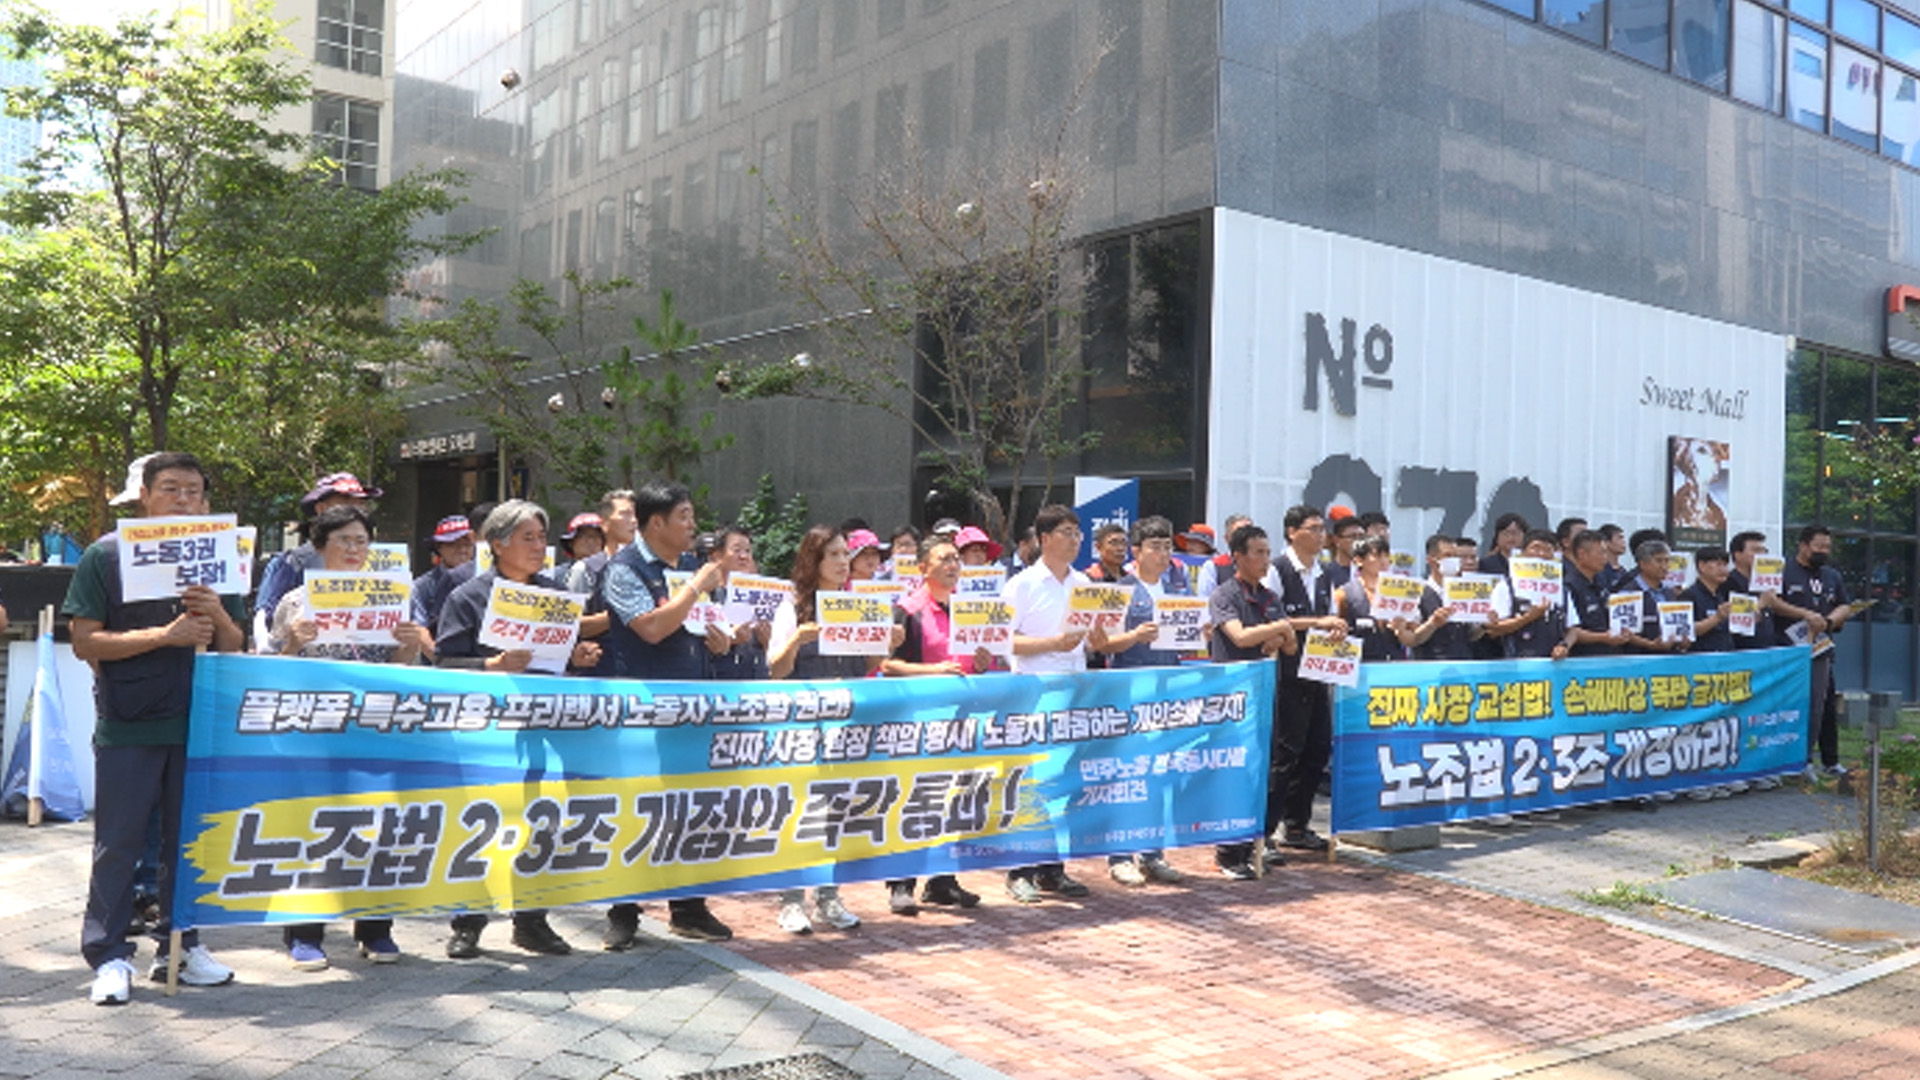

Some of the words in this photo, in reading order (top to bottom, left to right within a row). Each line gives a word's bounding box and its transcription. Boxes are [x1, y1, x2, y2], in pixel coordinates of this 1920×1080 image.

[1640, 376, 1695, 411] Sweet
[1698, 387, 1749, 420] Mall
[132, 538, 216, 566] 노동3권
[175, 560, 226, 587] 보장!
[624, 694, 710, 728] 노동자
[1367, 686, 1420, 728] 진짜
[1422, 684, 1474, 724] 사장
[1474, 680, 1554, 722] 교섭법!
[1563, 677, 1648, 716] 손해배상
[1650, 675, 1691, 709] 폭탄
[709, 729, 766, 768] 진짜
[767, 729, 821, 763] 사장
[874, 722, 922, 756] 책임
[1378, 737, 1505, 808] 노조법
[1511, 732, 1611, 795] 2·3조
[1611, 716, 1740, 780] 개정하라!
[220, 803, 444, 897] 노조법
[445, 798, 620, 880] 2·3조
[622, 783, 794, 865] 개정안
[794, 777, 900, 850] 즉각
